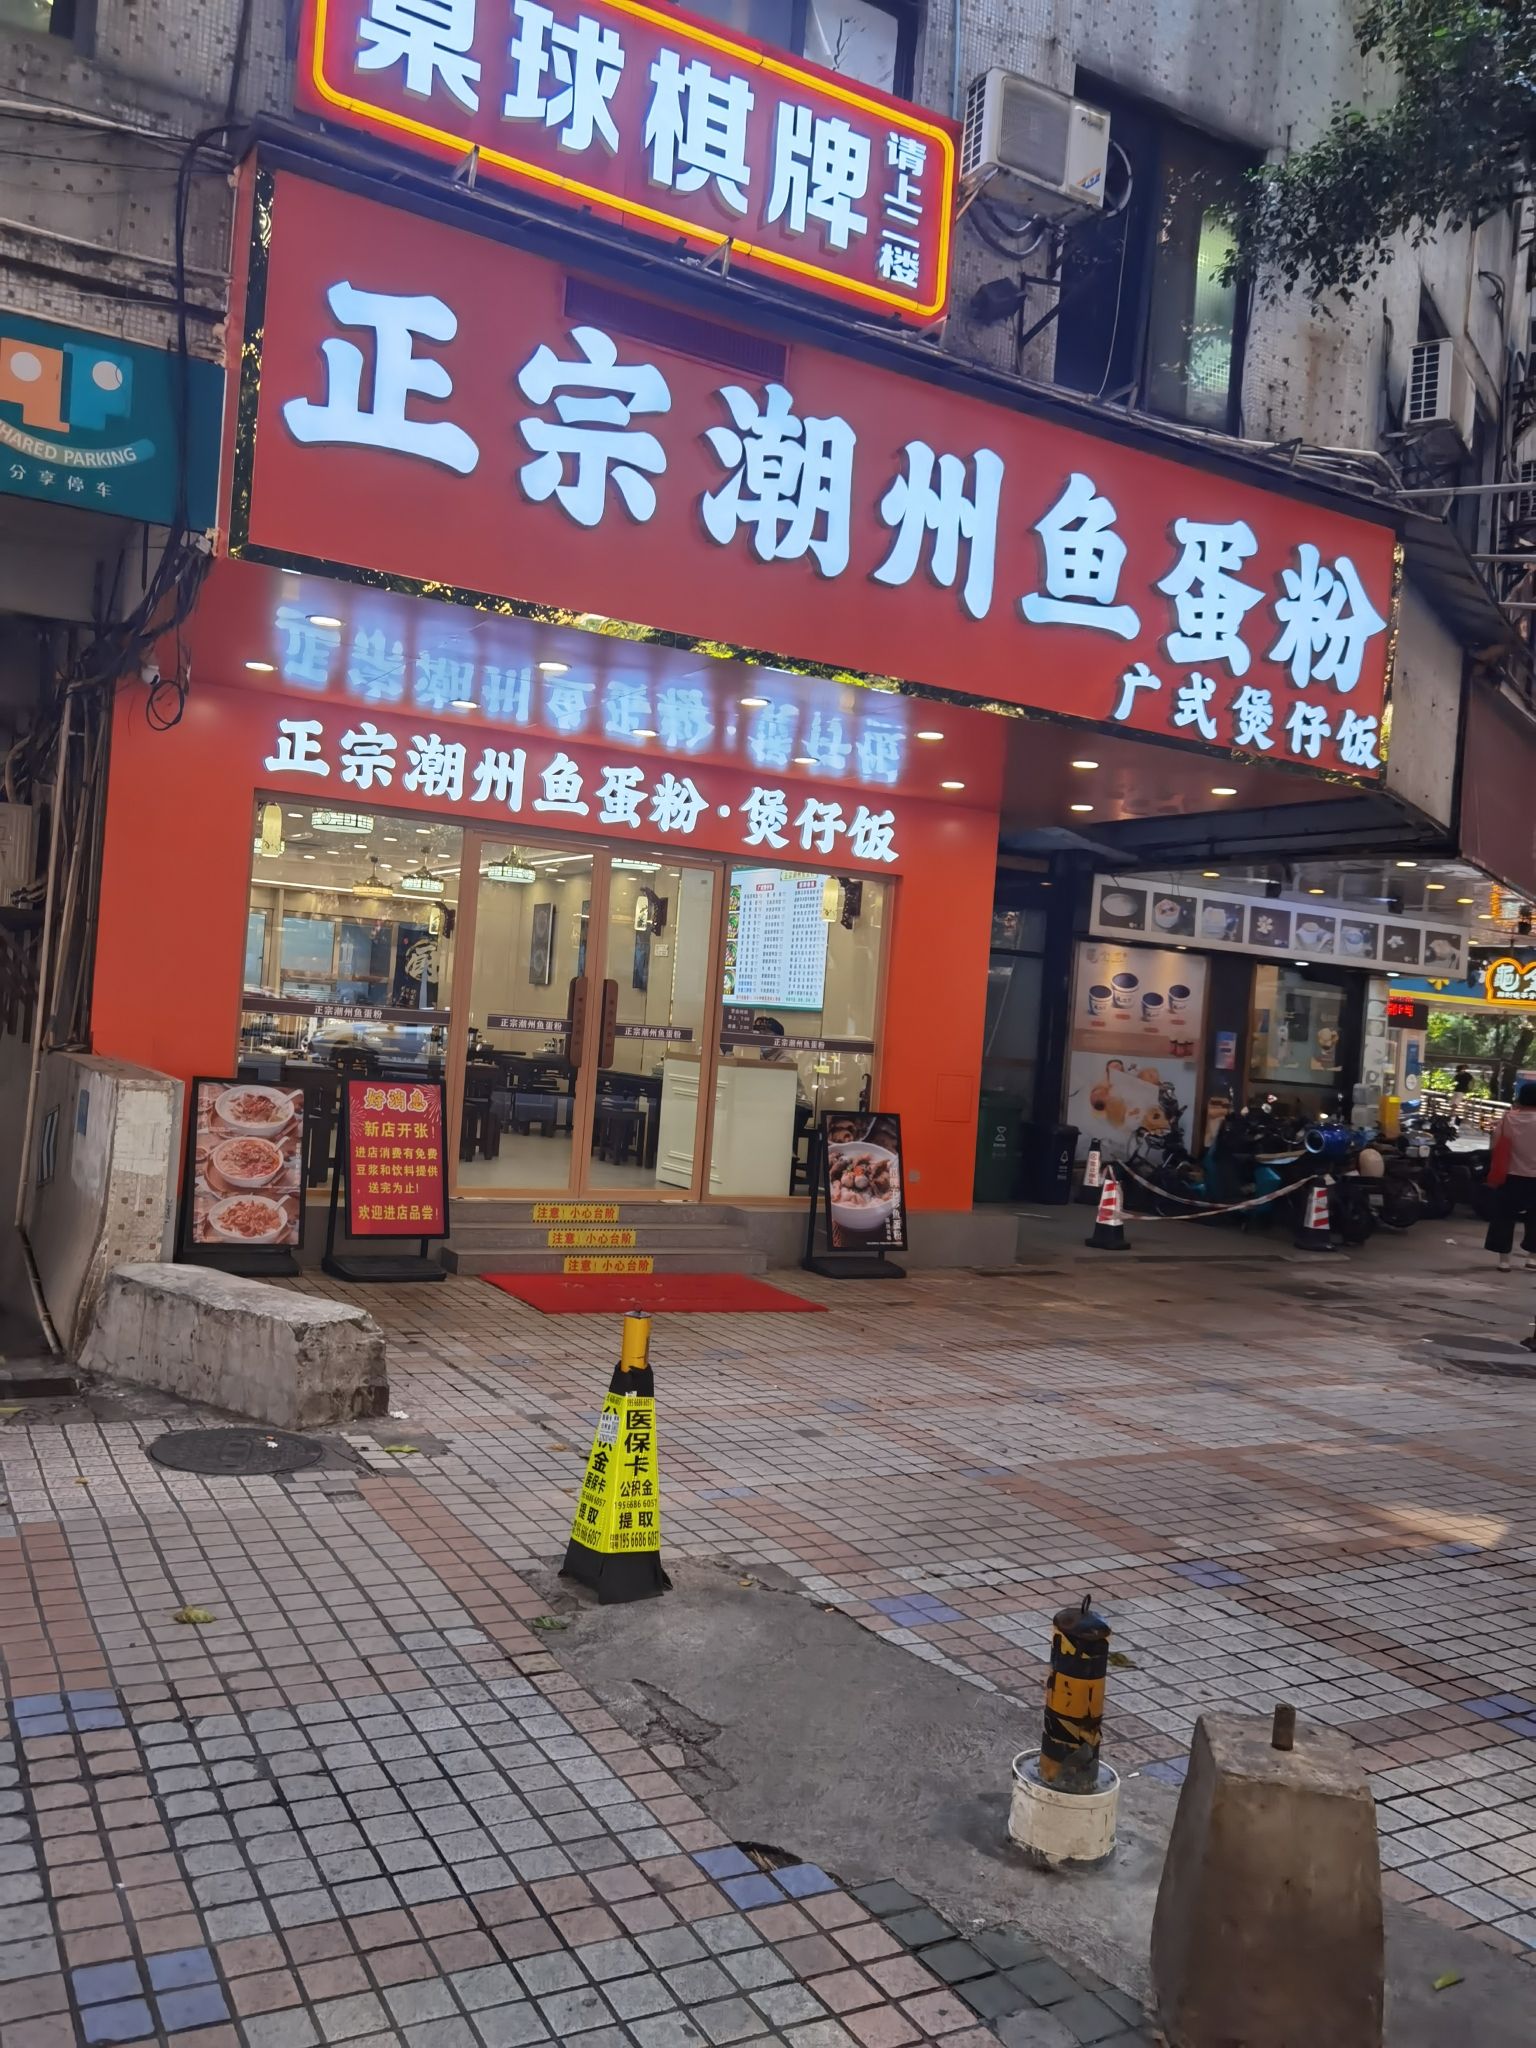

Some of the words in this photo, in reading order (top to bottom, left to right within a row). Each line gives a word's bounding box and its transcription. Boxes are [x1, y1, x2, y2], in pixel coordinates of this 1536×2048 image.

[357, 0, 873, 251] 桌球棋牌
[880, 132, 926, 290] 请上二楼
[0, 422, 57, 460] HARED
[64, 447, 136, 467] PARKING
[9, 464, 112, 497] 分享停车
[283, 281, 1387, 692] 正宗潮州鱼蛋粉
[1114, 663, 1380, 769] 广式煲仔饭
[314, 1005, 382, 1020] 正宗潮州鱼蛋粉
[500, 1018, 562, 1031] 正宗潮州鱼蛋粉
[624, 1027, 681, 1039] 正宗潮州鱼蛋粉
[774, 1038, 825, 1050] 正宗潮州鱼蛋粉
[364, 1087, 429, 1113] 好消息
[364, 1121, 435, 1139] 新店开张！
[355, 1146, 438, 1160] 进店消费有免费
[355, 1164, 438, 1177] 豆浆和饮料提供
[368, 1182, 419, 1194] 送完为止！
[358, 1205, 438, 1220] 欢迎进店品尝！
[624, 1409, 653, 1477] 医保卡
[584, 1472, 606, 1494] 医保卡
[620, 1479, 653, 1497] 公积金
[578, 1503, 599, 1525] 提取
[619, 1511, 653, 1530] 提取
